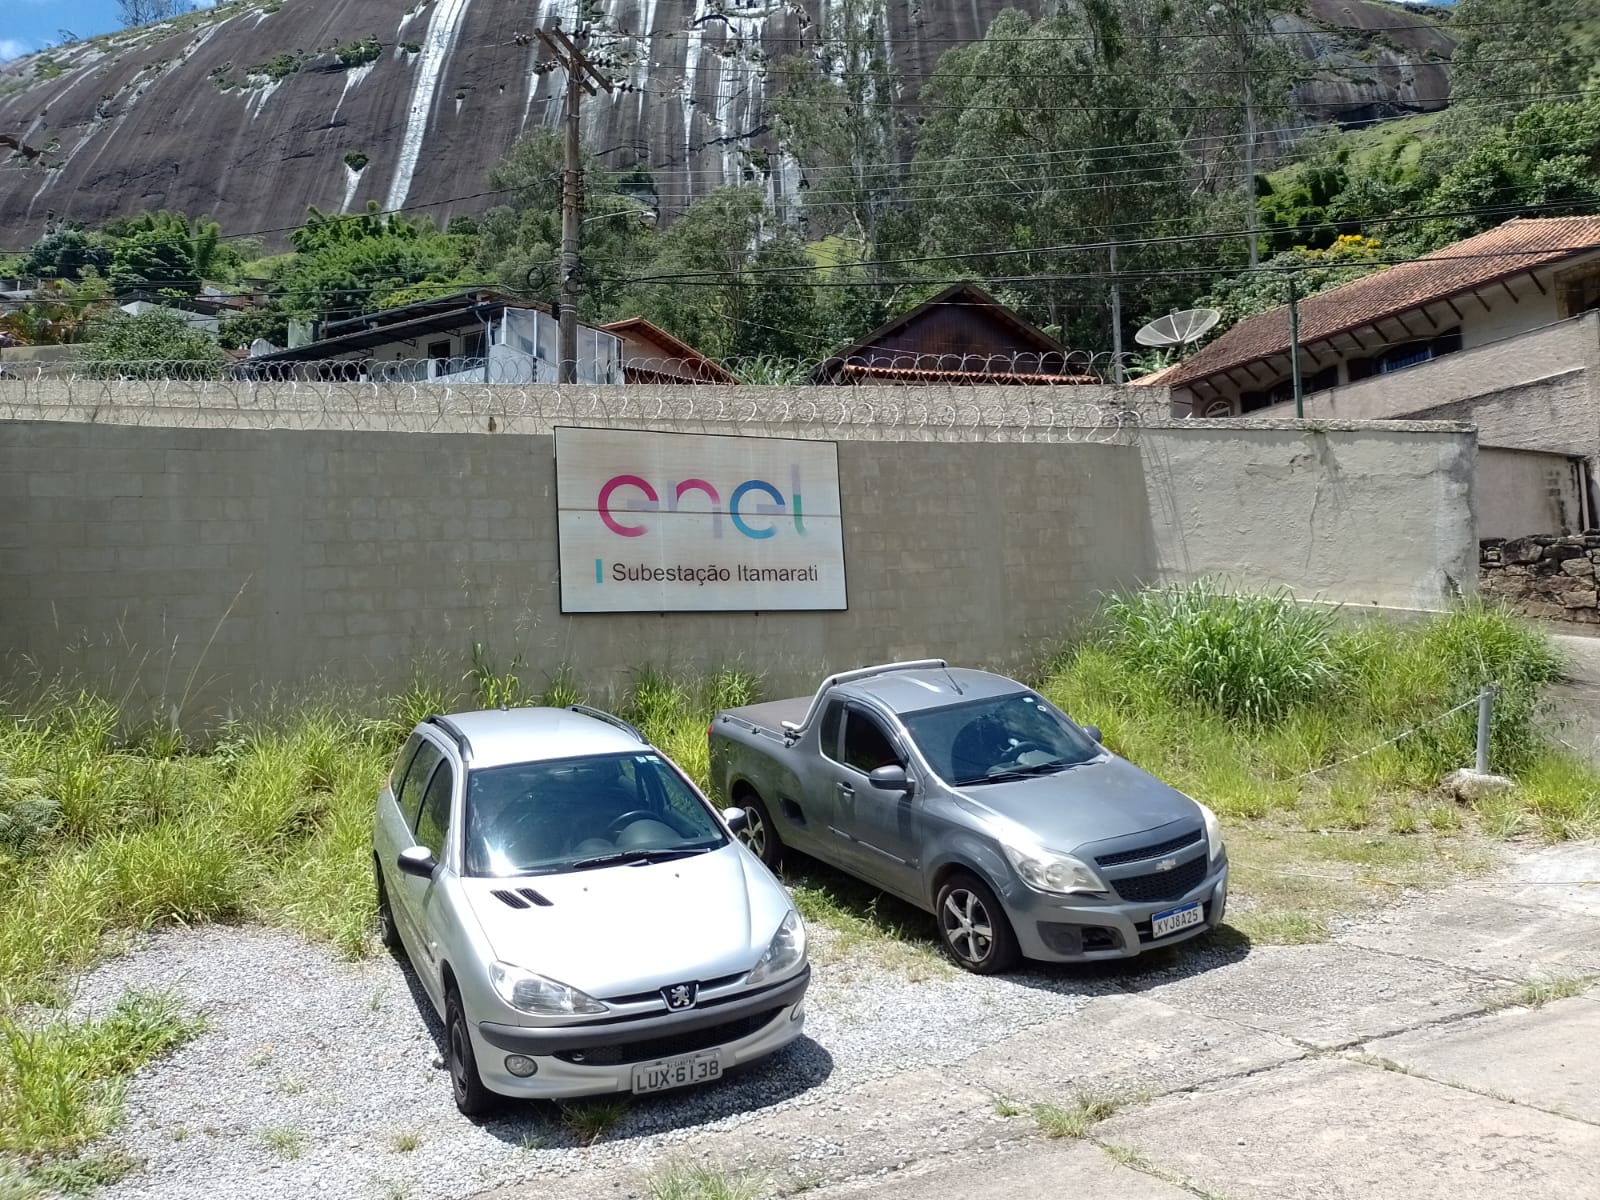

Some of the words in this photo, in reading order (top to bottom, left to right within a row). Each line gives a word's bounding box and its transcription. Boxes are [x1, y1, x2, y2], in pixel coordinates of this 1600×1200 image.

[597, 464, 808, 540] enel
[612, 563, 731, 586] Subestação
[737, 564, 819, 582] Itamarati
[1157, 909, 1198, 934] KYJ8A25
